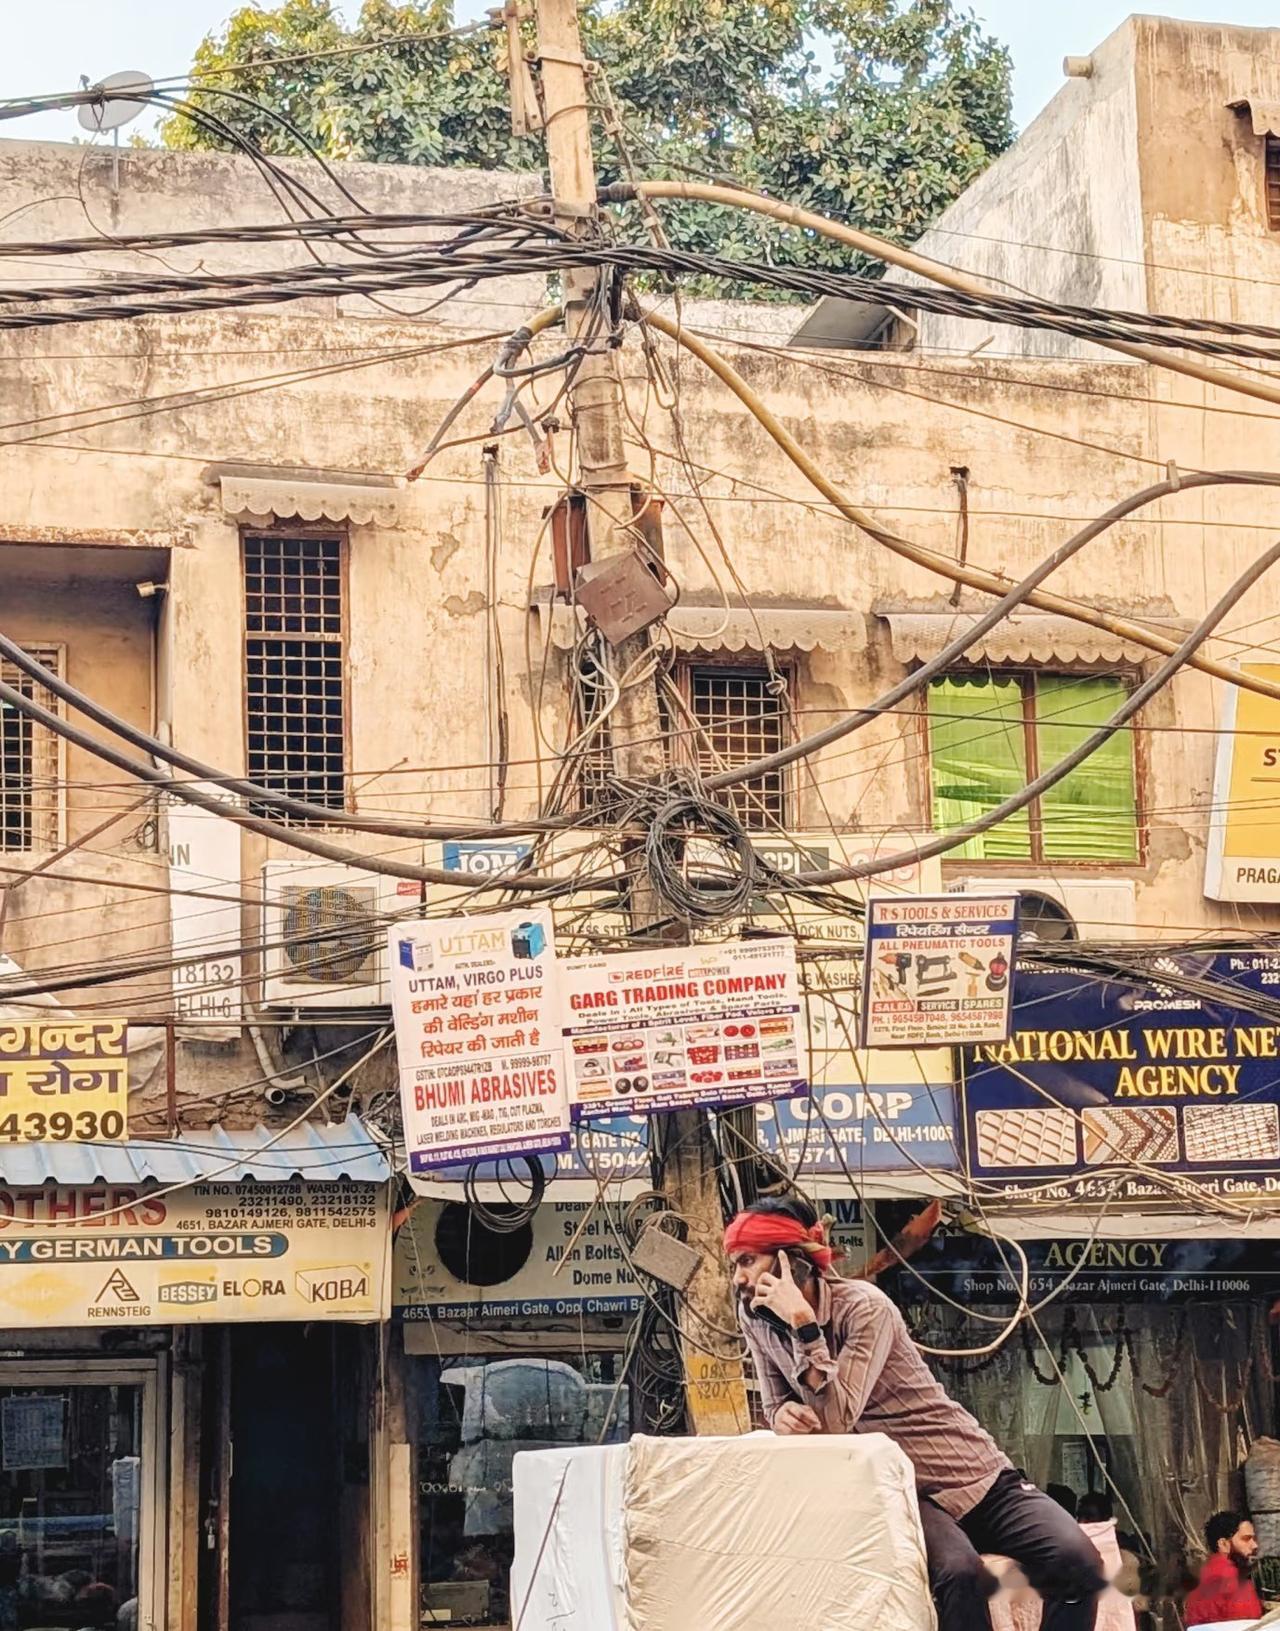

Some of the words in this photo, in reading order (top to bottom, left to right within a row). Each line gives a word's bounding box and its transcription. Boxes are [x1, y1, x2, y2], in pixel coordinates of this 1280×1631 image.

[1263, 748, 1280, 766] S
[1236, 867, 1280, 883] PRAG
[880, 908, 888, 920] R
[891, 908, 899, 919] S
[902, 906, 938, 921] TOOLS
[942, 906, 951, 918] &
[953, 904, 1009, 919] SERVICES
[826, 925, 861, 939] NUTS,
[439, 931, 506, 954] UTTAM
[879, 941, 899, 951] ALL
[902, 939, 966, 950] PNEUMATIC
[970, 937, 1006, 948] TOOLS
[409, 976, 460, 993] UTTAM,
[464, 969, 505, 987] VIRGO
[509, 965, 543, 981] PLUS
[411, 994, 449, 1014] हमारे
[482, 992, 502, 1006] हर
[503, 985, 543, 1004] प्रकार
[570, 990, 618, 1011] GARG
[621, 981, 699, 1005] TRADING
[703, 973, 787, 997] COMPANY
[646, 1003, 677, 1013] Types
[920, 1001, 957, 1010] SERVICE
[963, 999, 1002, 1009] SPARES
[1134, 1000, 1201, 1010] PROMESH
[422, 1016, 443, 1034] की
[447, 1011, 494, 1031] वेल्डिंग
[497, 1006, 539, 1025] मशीन
[420, 1038, 463, 1058] रिपेयर
[466, 1034, 487, 1053] की
[490, 1030, 525, 1049] जाती
[528, 1027, 541, 1046] है
[1143, 1027, 1228, 1059] WIRE
[1229, 1026, 1280, 1058] NE
[414, 1079, 465, 1111] BHUMI
[471, 1068, 557, 1104] ABRASIVES
[1114, 1064, 1242, 1098] AGENCY
[790, 1091, 913, 1121] CORP
[431, 1113, 448, 1127] DEALS
[416, 1130, 434, 1145] LASER
[434, 1126, 459, 1142] WELDING
[489, 1119, 525, 1136] REGULATORS
[525, 1118, 537, 1131] AND
[581, 1132, 618, 1148] GATE
[194, 1185, 210, 1196] TIN
[213, 1185, 233, 1196] NO.
[307, 1184, 340, 1194] WARD
[342, 1184, 361, 1194] NO.
[364, 1184, 376, 1194] 24
[1046, 1186, 1071, 1198] No.
[311, 1195, 376, 1206] 23218132
[205, 1208, 291, 1219] 9810149126,
[296, 1207, 376, 1218] 9811542575
[176, 1220, 205, 1231] 4651,
[208, 1219, 247, 1230] BAZAR
[251, 1218, 293, 1229] AJMERI
[297, 1218, 330, 1229] GATE,
[333, 1217, 376, 1228] DELHI-6
[563, 1220, 599, 1236] Steel
[30, 1238, 163, 1259] GERMAN
[171, 1235, 272, 1256] TOOLS
[546, 1245, 581, 1262] Allen
[585, 1244, 626, 1262] Bolts,
[1043, 1242, 1168, 1268] AGENCY
[573, 1270, 613, 1285] Dome
[963, 1279, 994, 1294] Shop
[997, 1279, 1017, 1291] No.
[1097, 1279, 1137, 1294] Ajmeri
[1140, 1279, 1169, 1293] Gate,
[1173, 1278, 1250, 1292] Delhi-110006
[161, 1286, 215, 1301] BESSEY
[223, 1279, 286, 1297] ELORA
[312, 1278, 367, 1303] KOBA
[88, 1305, 151, 1318] RENNSTEIG
[437, 1306, 479, 1320] Bazaar
[586, 1299, 627, 1314] Chawri
